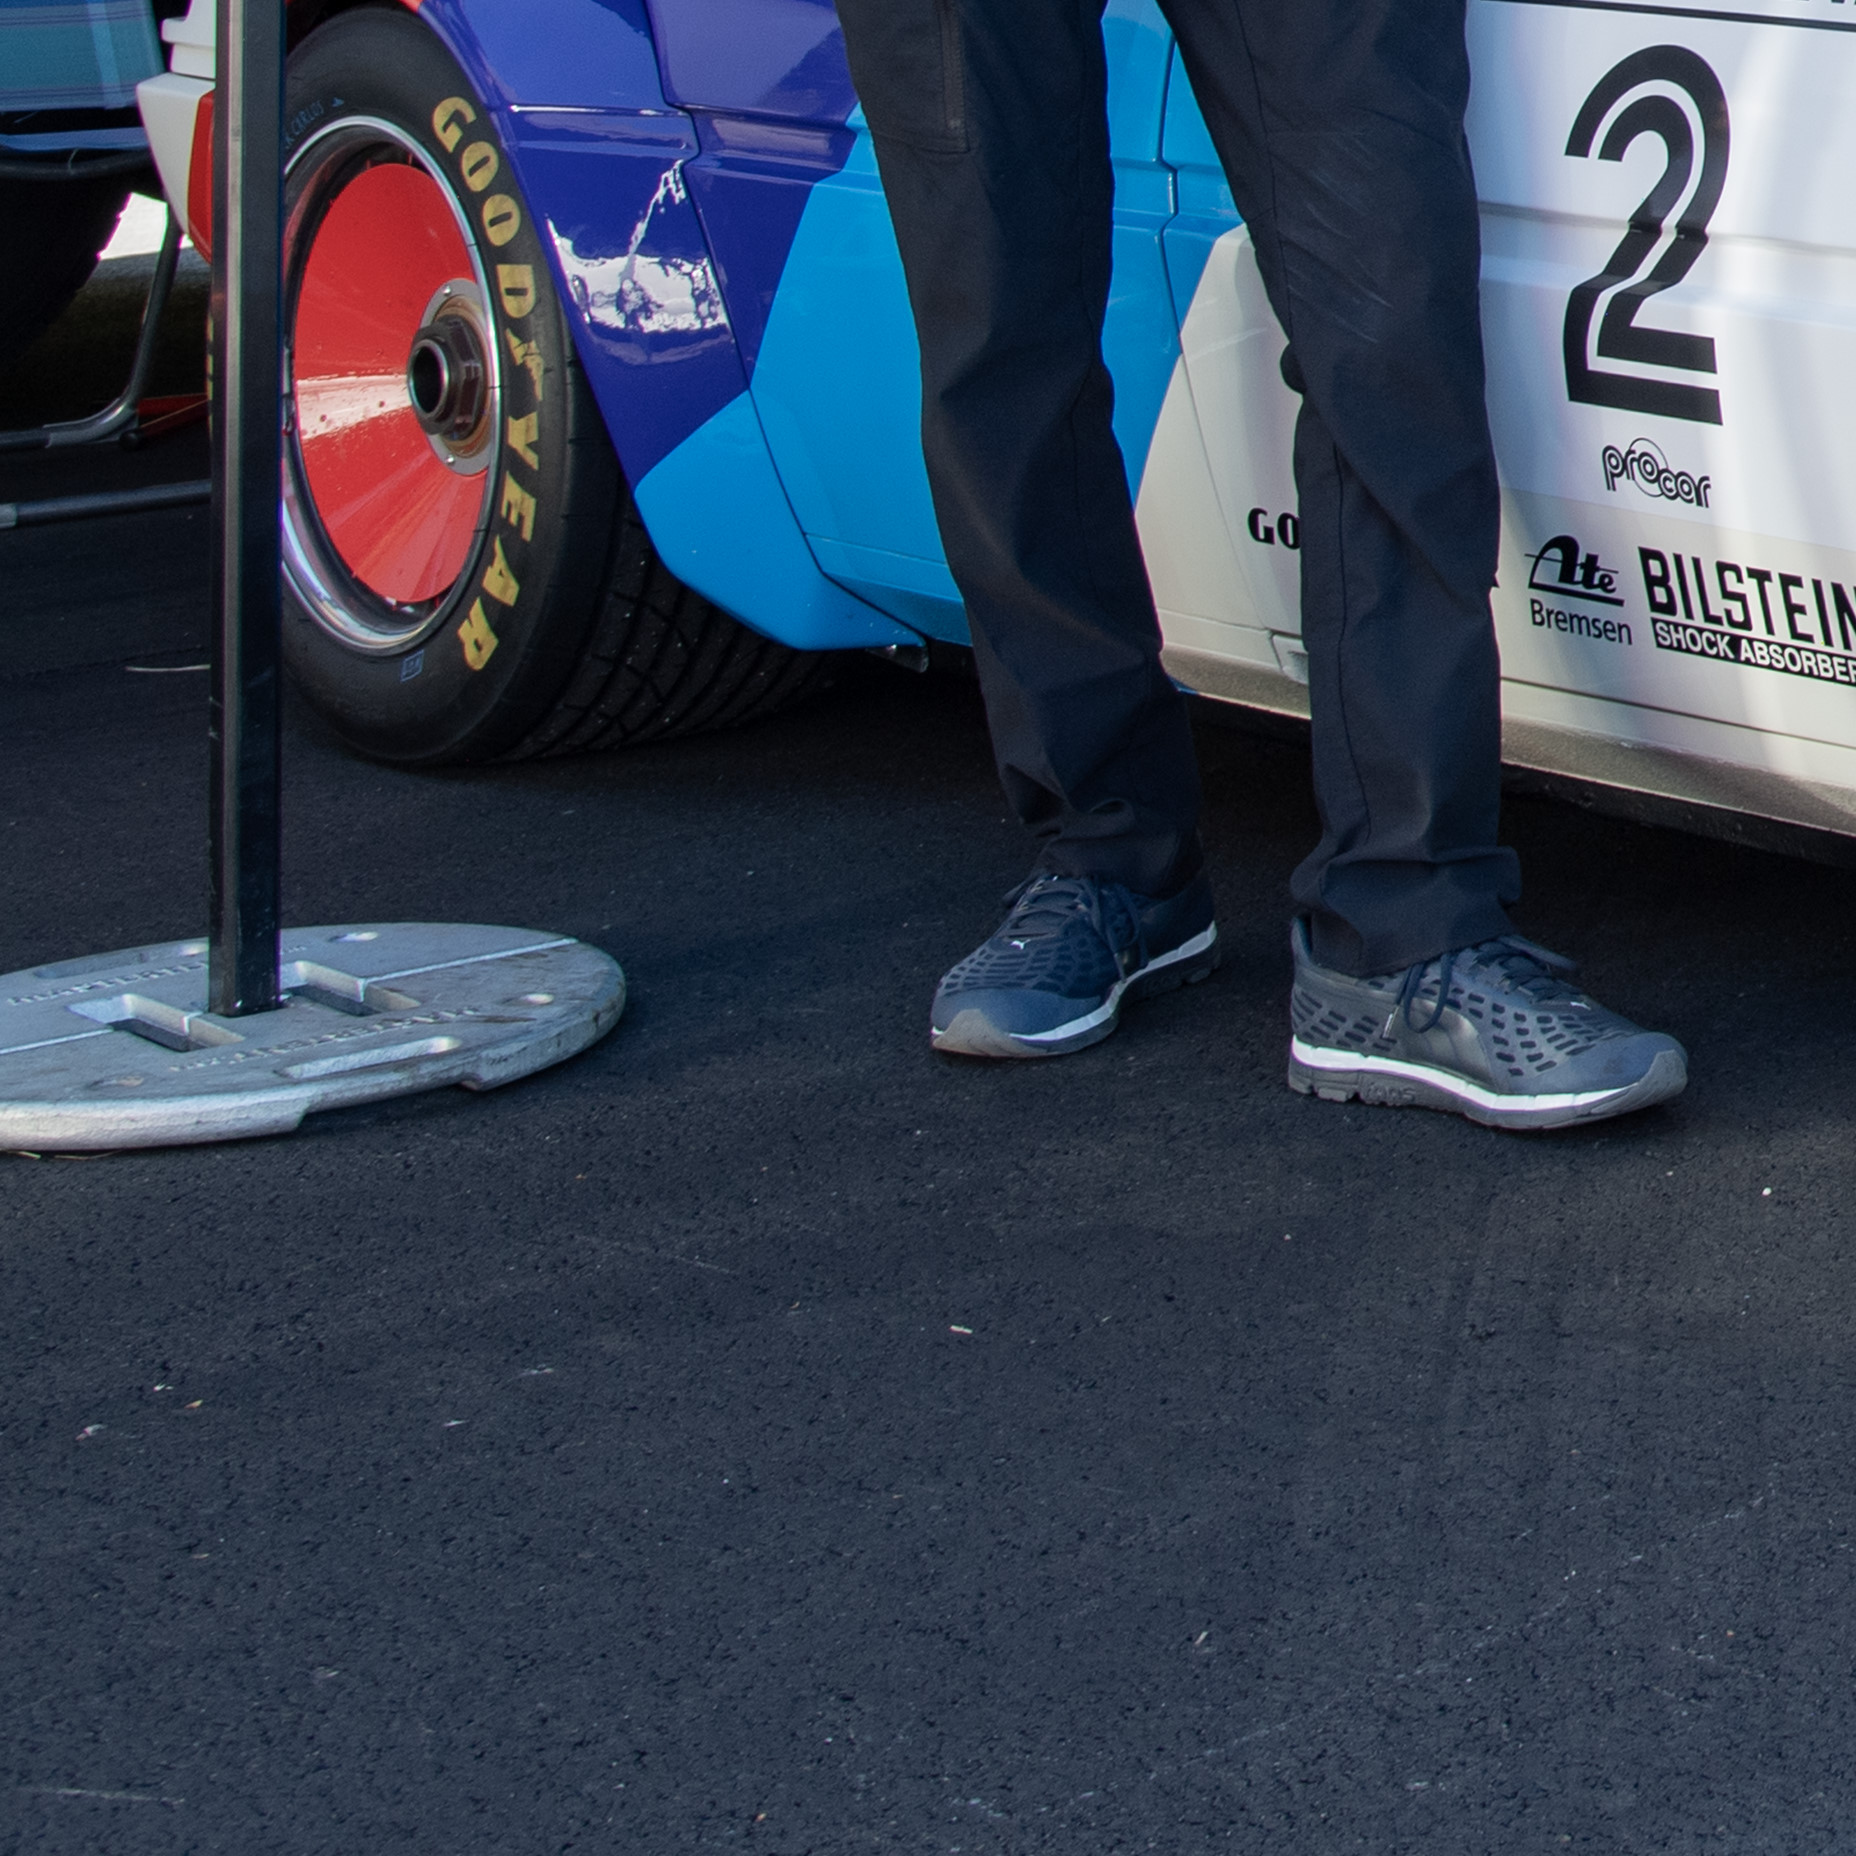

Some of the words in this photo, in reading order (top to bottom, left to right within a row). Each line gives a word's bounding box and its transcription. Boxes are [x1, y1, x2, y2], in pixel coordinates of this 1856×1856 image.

[1563, 43, 1732, 427] 2
[1602, 444, 1712, 509] procar
[1530, 598, 1633, 646] Bremsen
[1655, 621, 1735, 660] SHOCK
